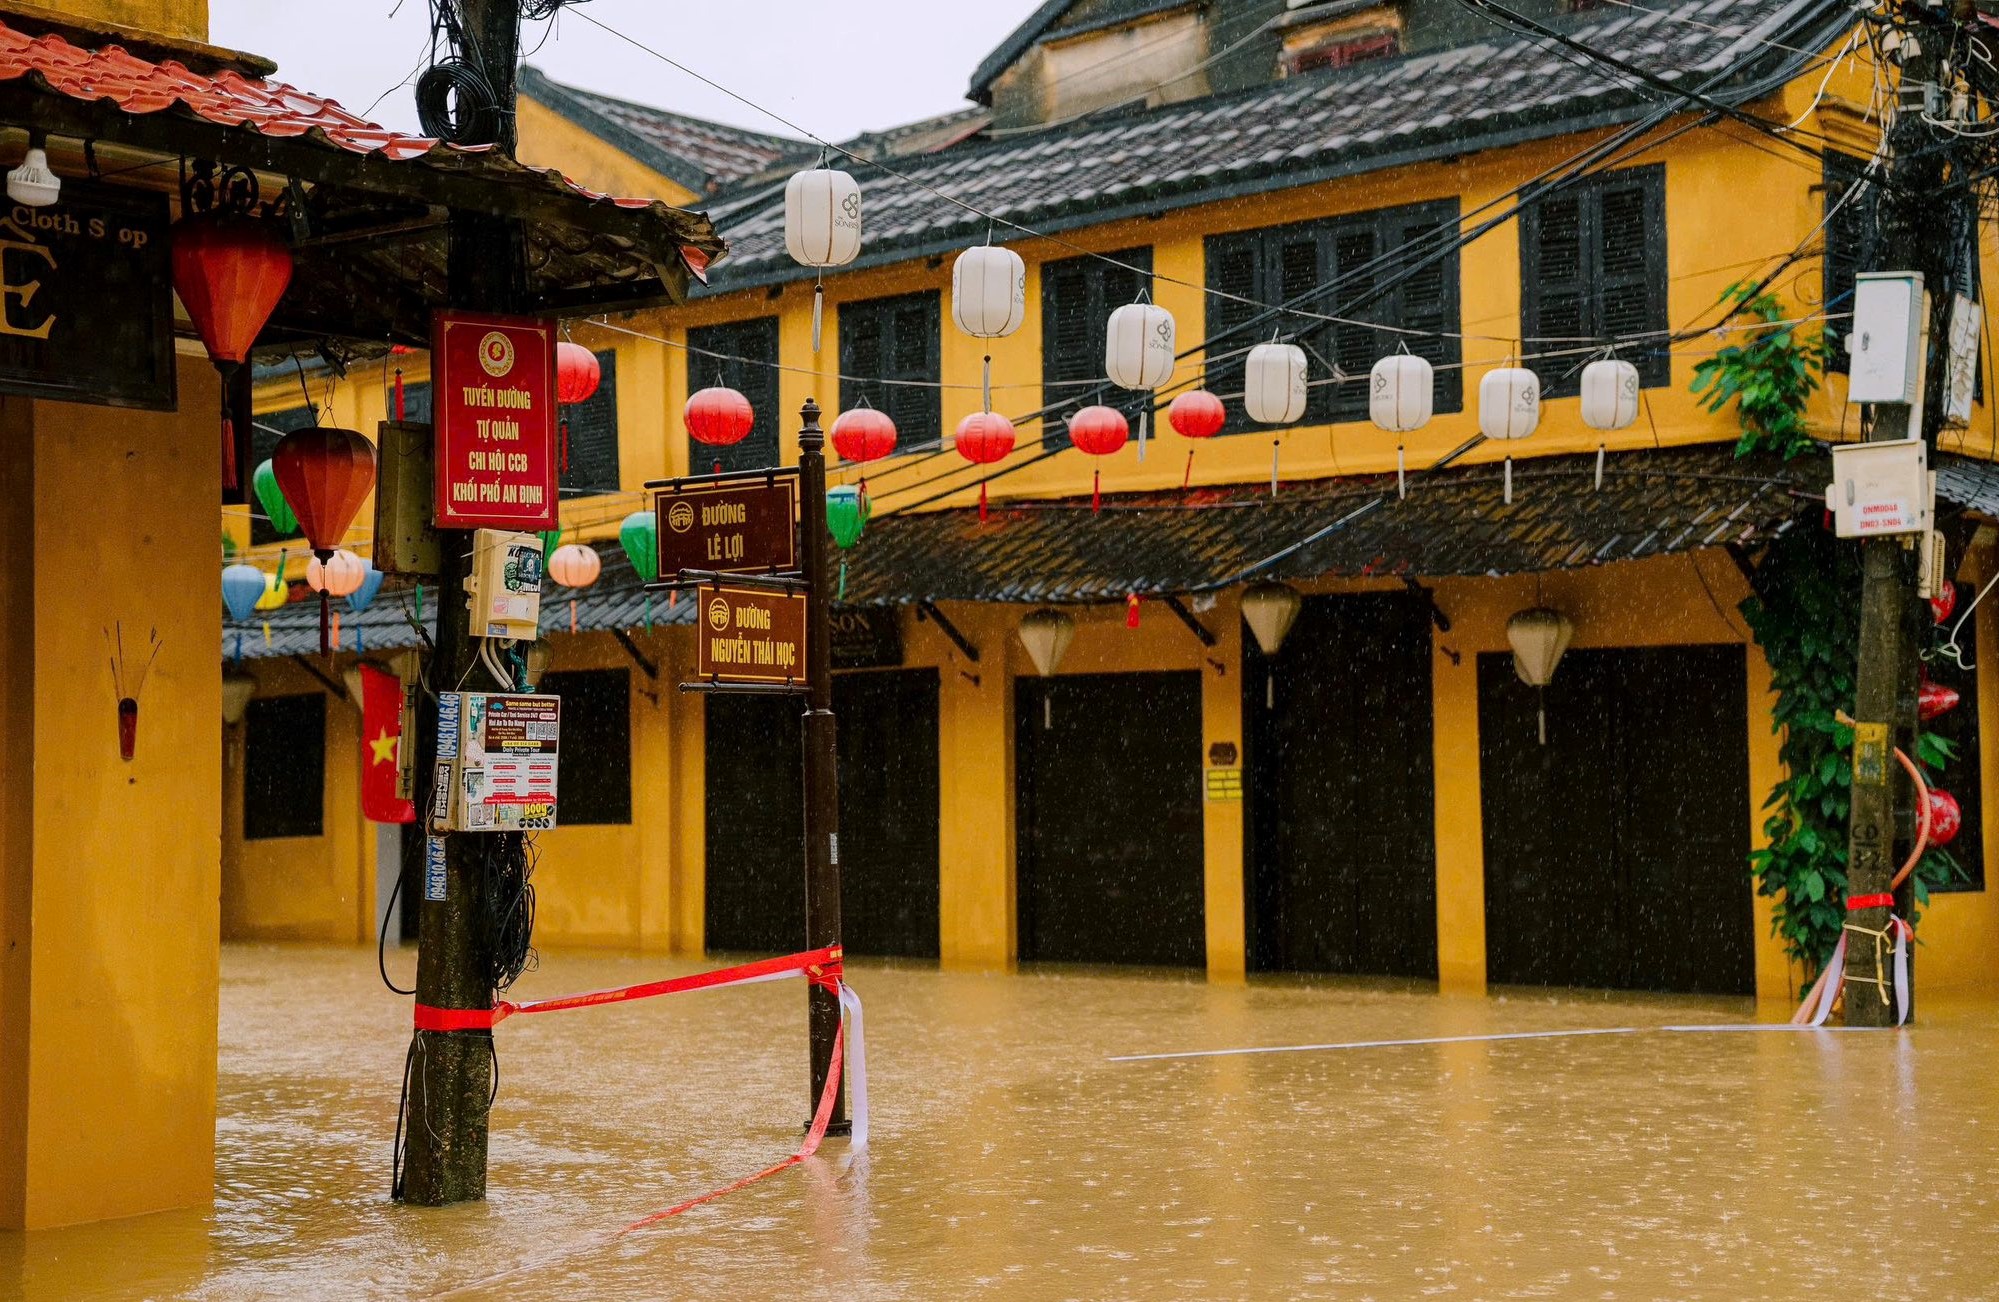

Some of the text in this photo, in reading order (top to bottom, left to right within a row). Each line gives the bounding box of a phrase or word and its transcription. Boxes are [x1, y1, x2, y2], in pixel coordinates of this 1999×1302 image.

[11, 206, 81, 235] Cloth
[462, 382, 531, 410] TUYẾN ĐƯỜNG
[476, 414, 519, 443] TỰ QUẢN
[468, 448, 528, 475] CHI HỘI CCB
[453, 476, 543, 508] KHỐI PHỐ AN ĐỊNH
[702, 499, 746, 527] ĐƯỜNG
[707, 532, 744, 562] LÊ LỢI
[735, 602, 771, 630] ĐƯỜNG
[711, 631, 795, 669] NGUYỄN THÁI HỌC
